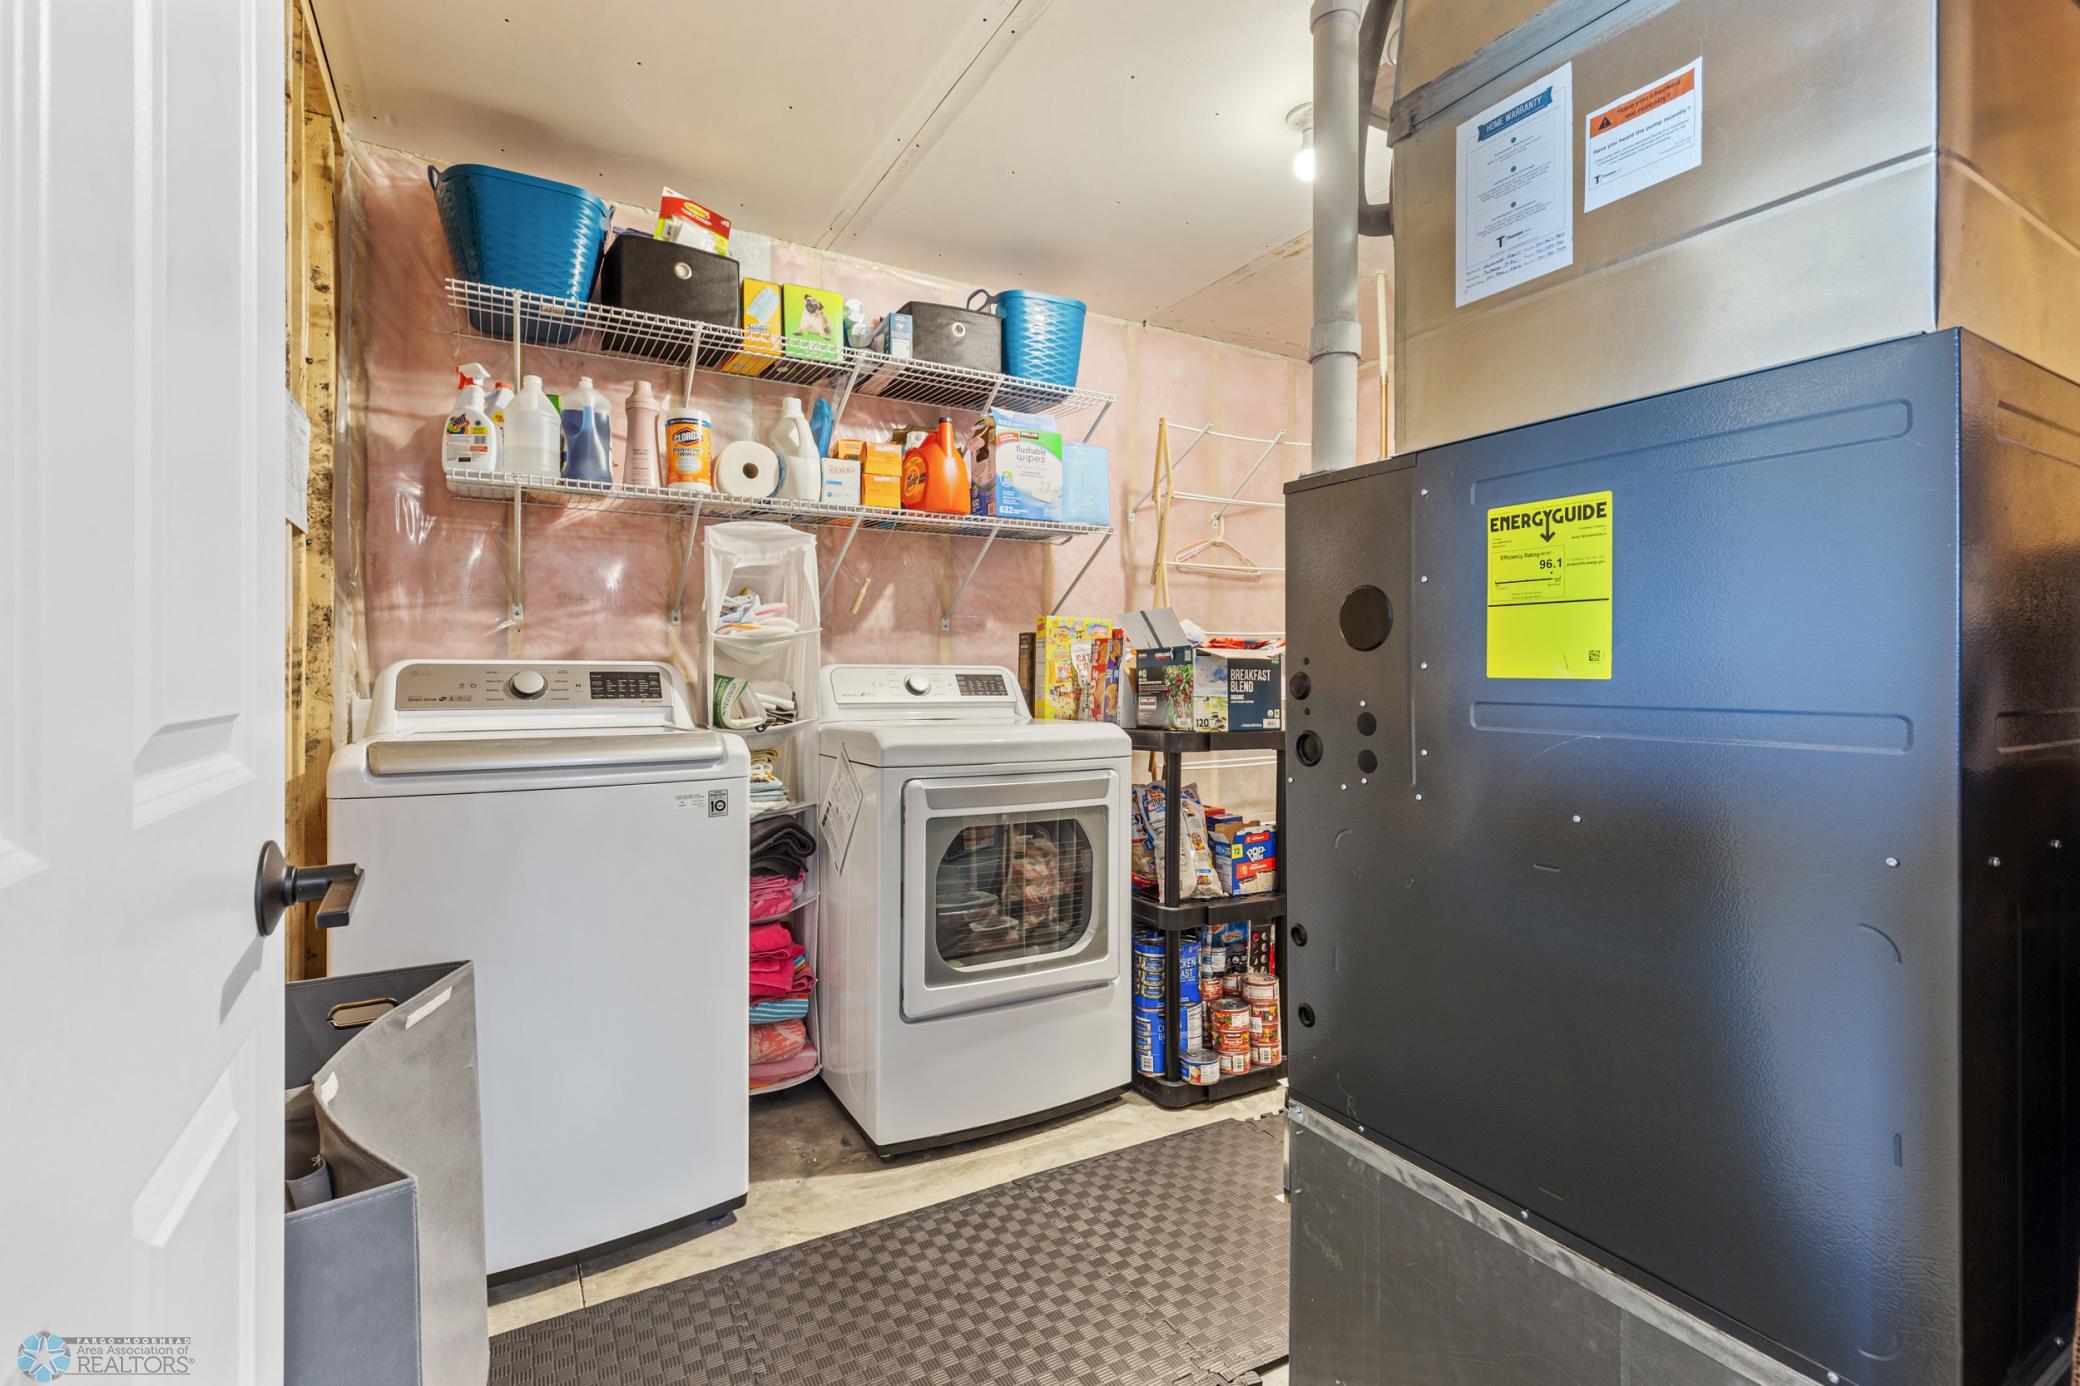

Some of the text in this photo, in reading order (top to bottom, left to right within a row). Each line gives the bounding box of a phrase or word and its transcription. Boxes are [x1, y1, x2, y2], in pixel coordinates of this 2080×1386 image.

[1636, 97, 1649, 108] you
[1650, 80, 1681, 99] checked
[1637, 92, 1671, 113] recently?
[1486, 95, 1542, 133] HOME WARRANTY
[1593, 105, 1692, 154] Have you heard the pump recently?
[674, 431, 704, 442] CLOROX
[1016, 443, 1046, 456] flushable
[1016, 454, 1046, 464] wipes
[999, 505, 1013, 514] 632
[1490, 501, 1608, 533] ENERGYGUIDE
[1500, 550, 1540, 562] Efficiency Rating
[1539, 557, 1562, 570] 96.1
[1230, 668, 1272, 681] BREAKFAST
[1230, 680, 1254, 693] BLEND
[1195, 718, 1210, 728] 120
